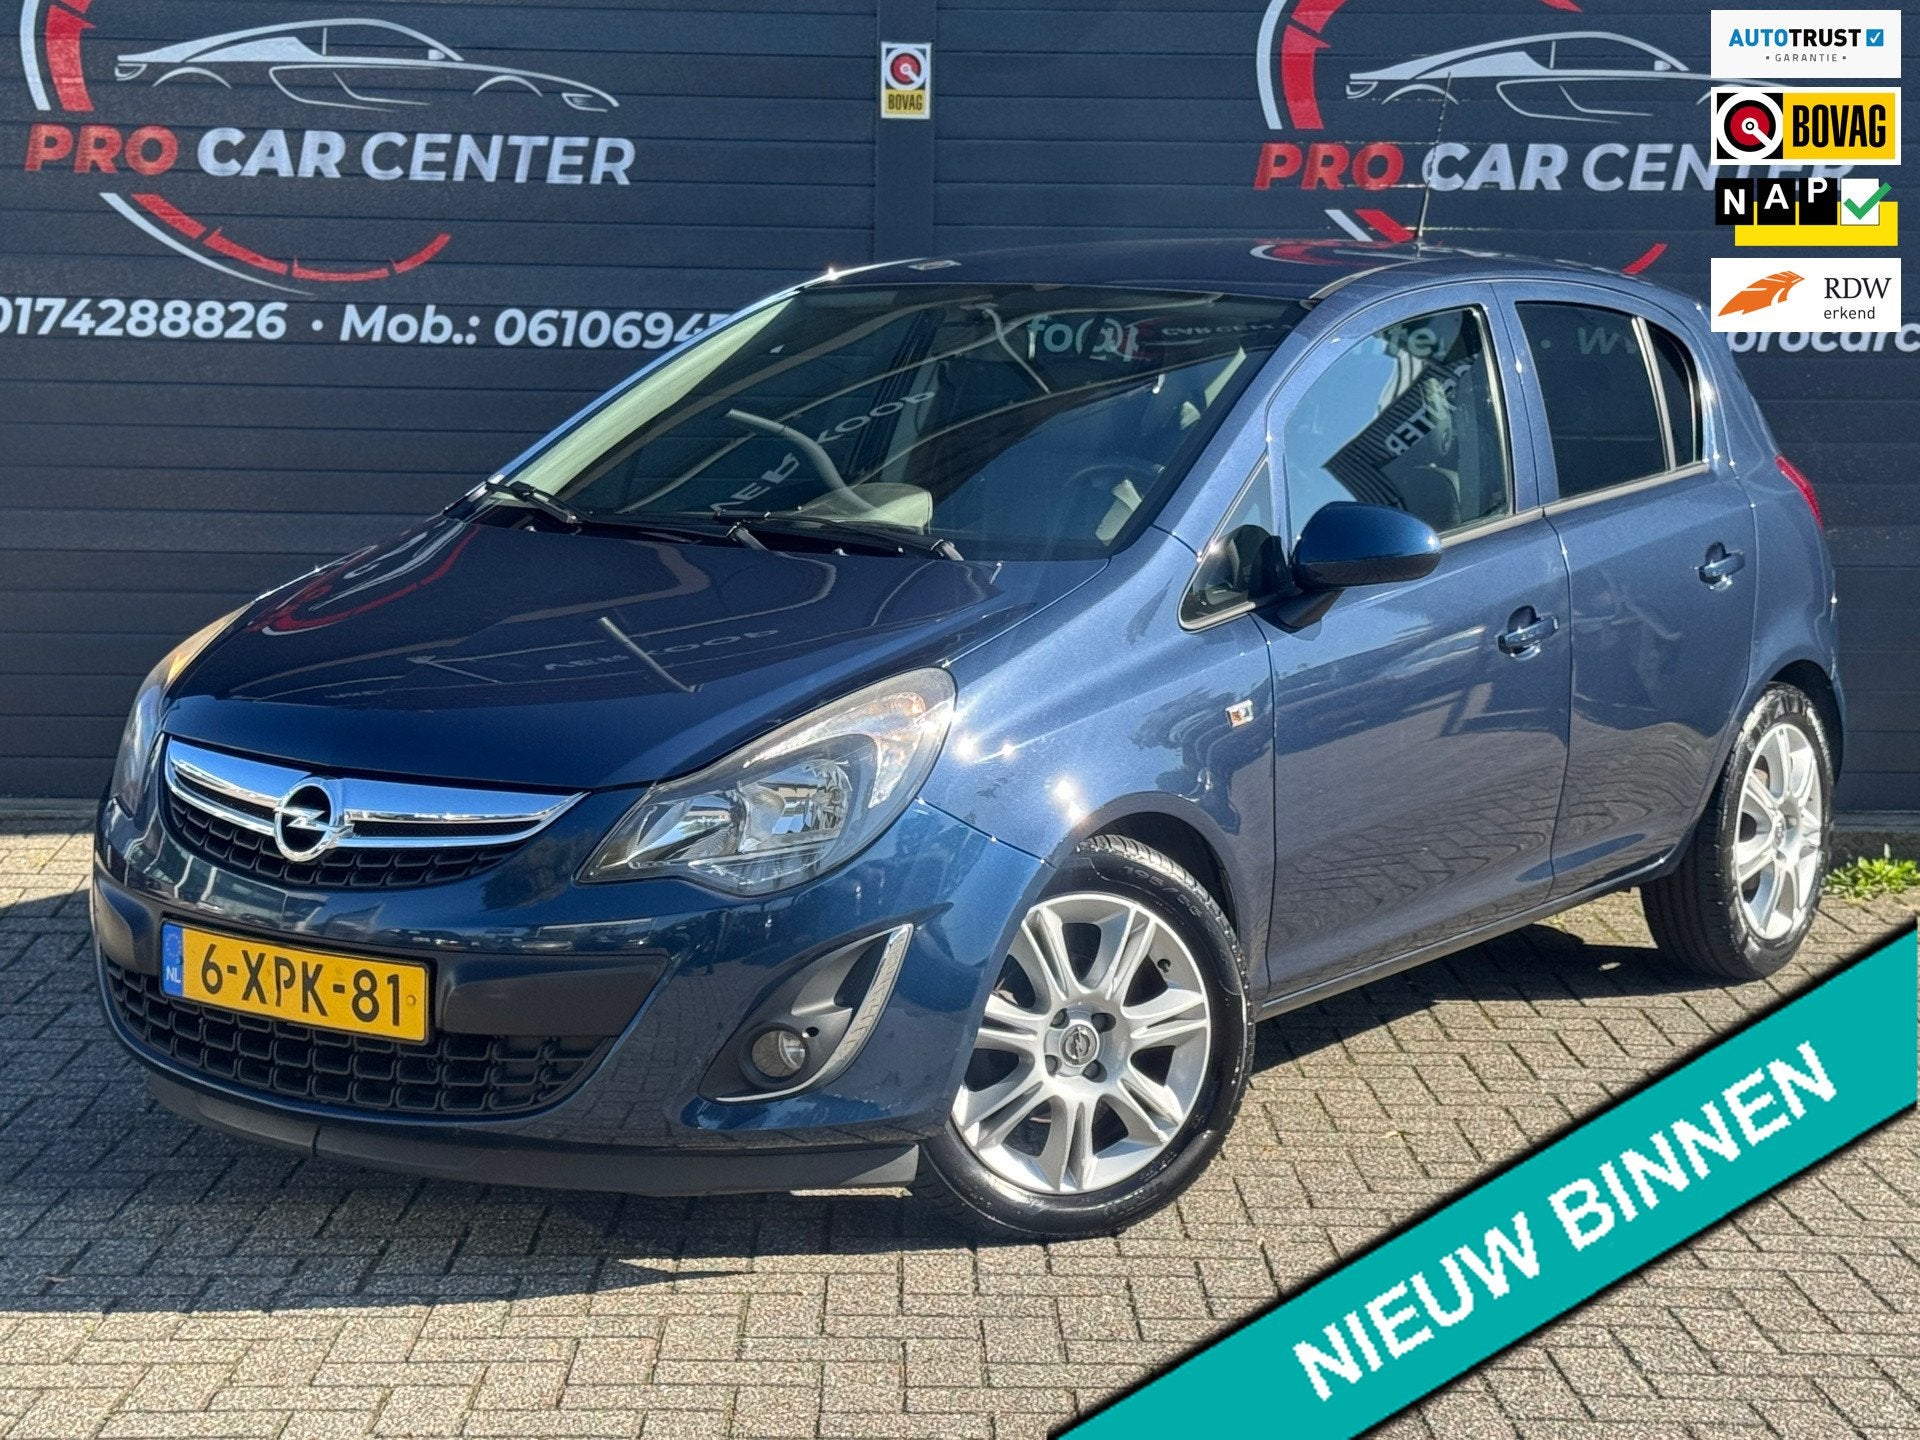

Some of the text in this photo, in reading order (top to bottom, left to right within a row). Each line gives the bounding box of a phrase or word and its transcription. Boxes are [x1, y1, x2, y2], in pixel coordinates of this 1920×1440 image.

[888, 93, 923, 111] BOVAG
[24, 122, 636, 186] PRO CAR CENTER
[1253, 142, 1853, 191] PRO CAR CEN
[494, 308, 738, 349] 0610694
[166, 943, 400, 1026] NL 6-XPK-81
